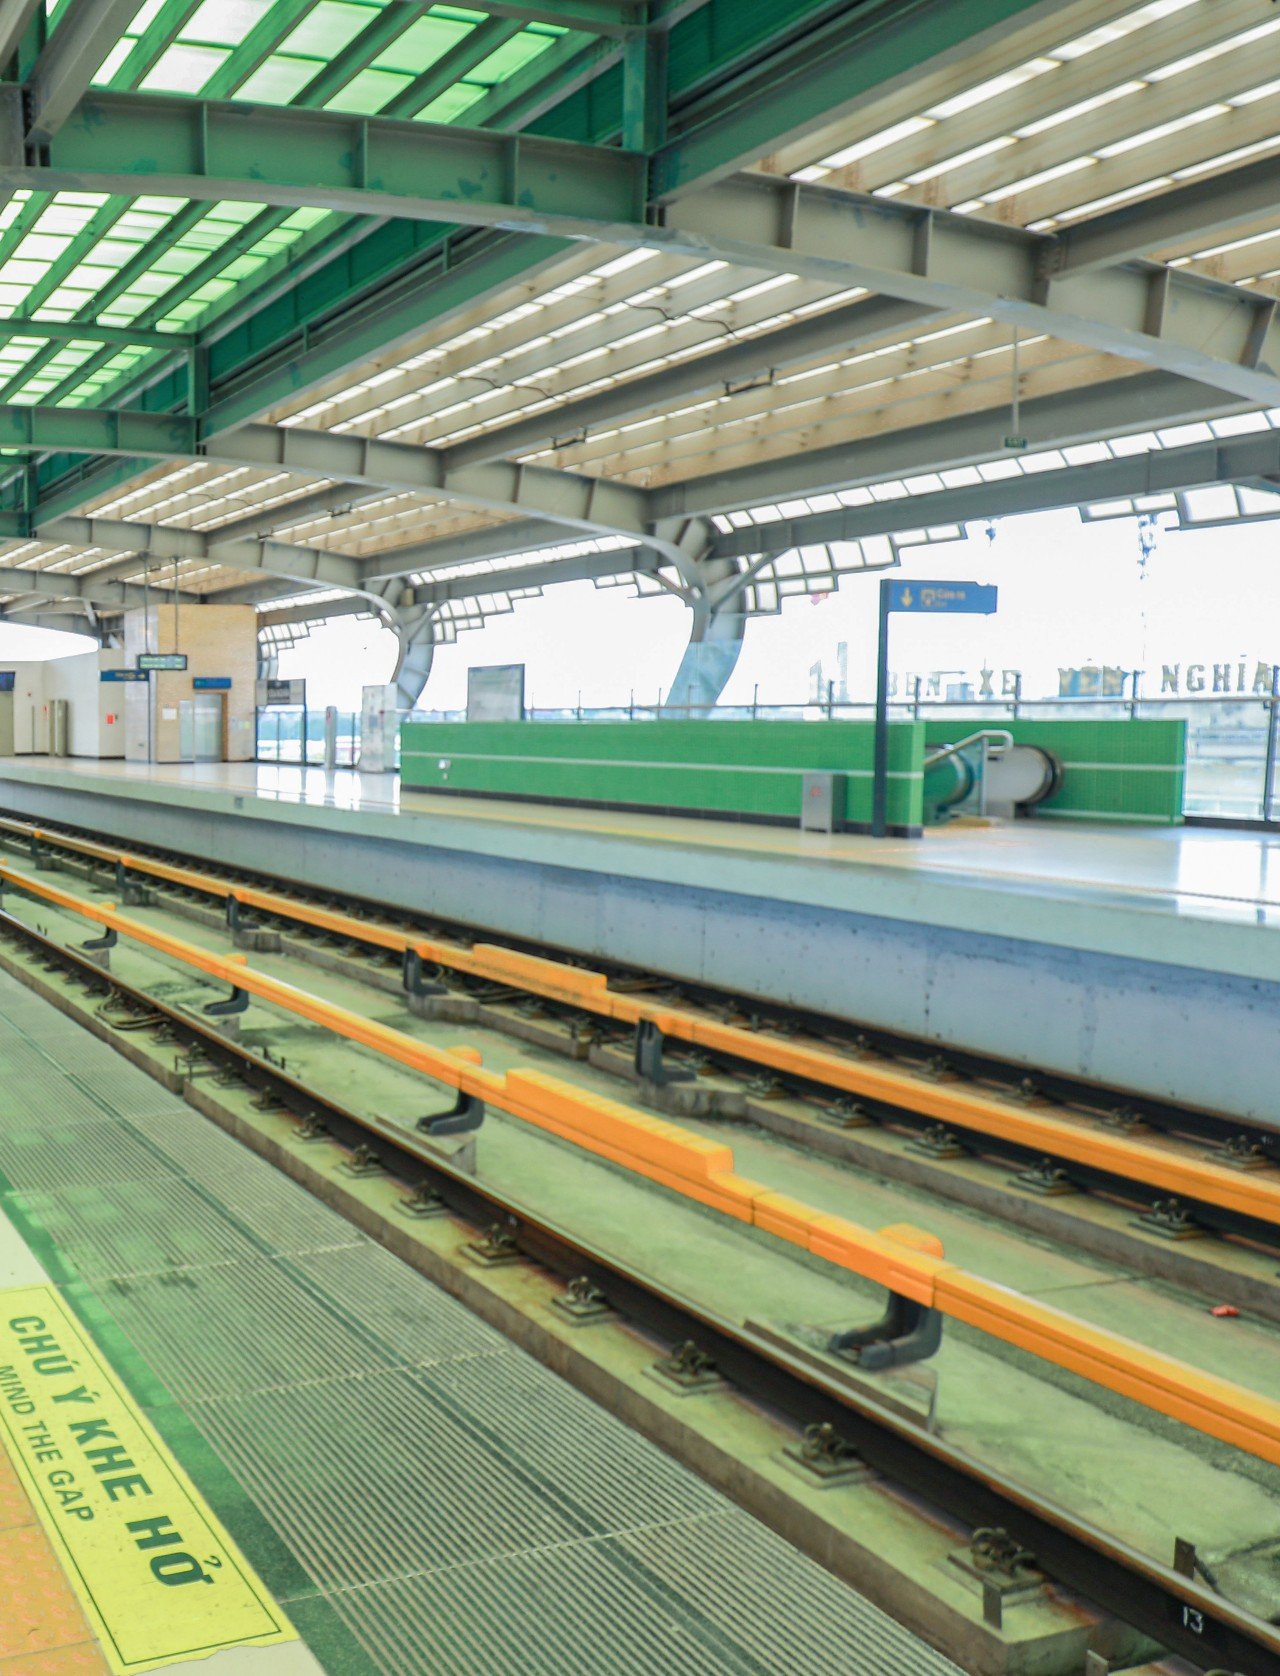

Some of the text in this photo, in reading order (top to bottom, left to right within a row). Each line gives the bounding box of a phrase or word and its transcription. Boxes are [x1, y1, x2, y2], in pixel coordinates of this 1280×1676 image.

[8, 1315, 223, 1587] CHÚ Ý KHE HỞ
[23, 1420, 63, 1463] THE
[47, 1470, 95, 1522] GAP
[1183, 1606, 1202, 1634] 13
